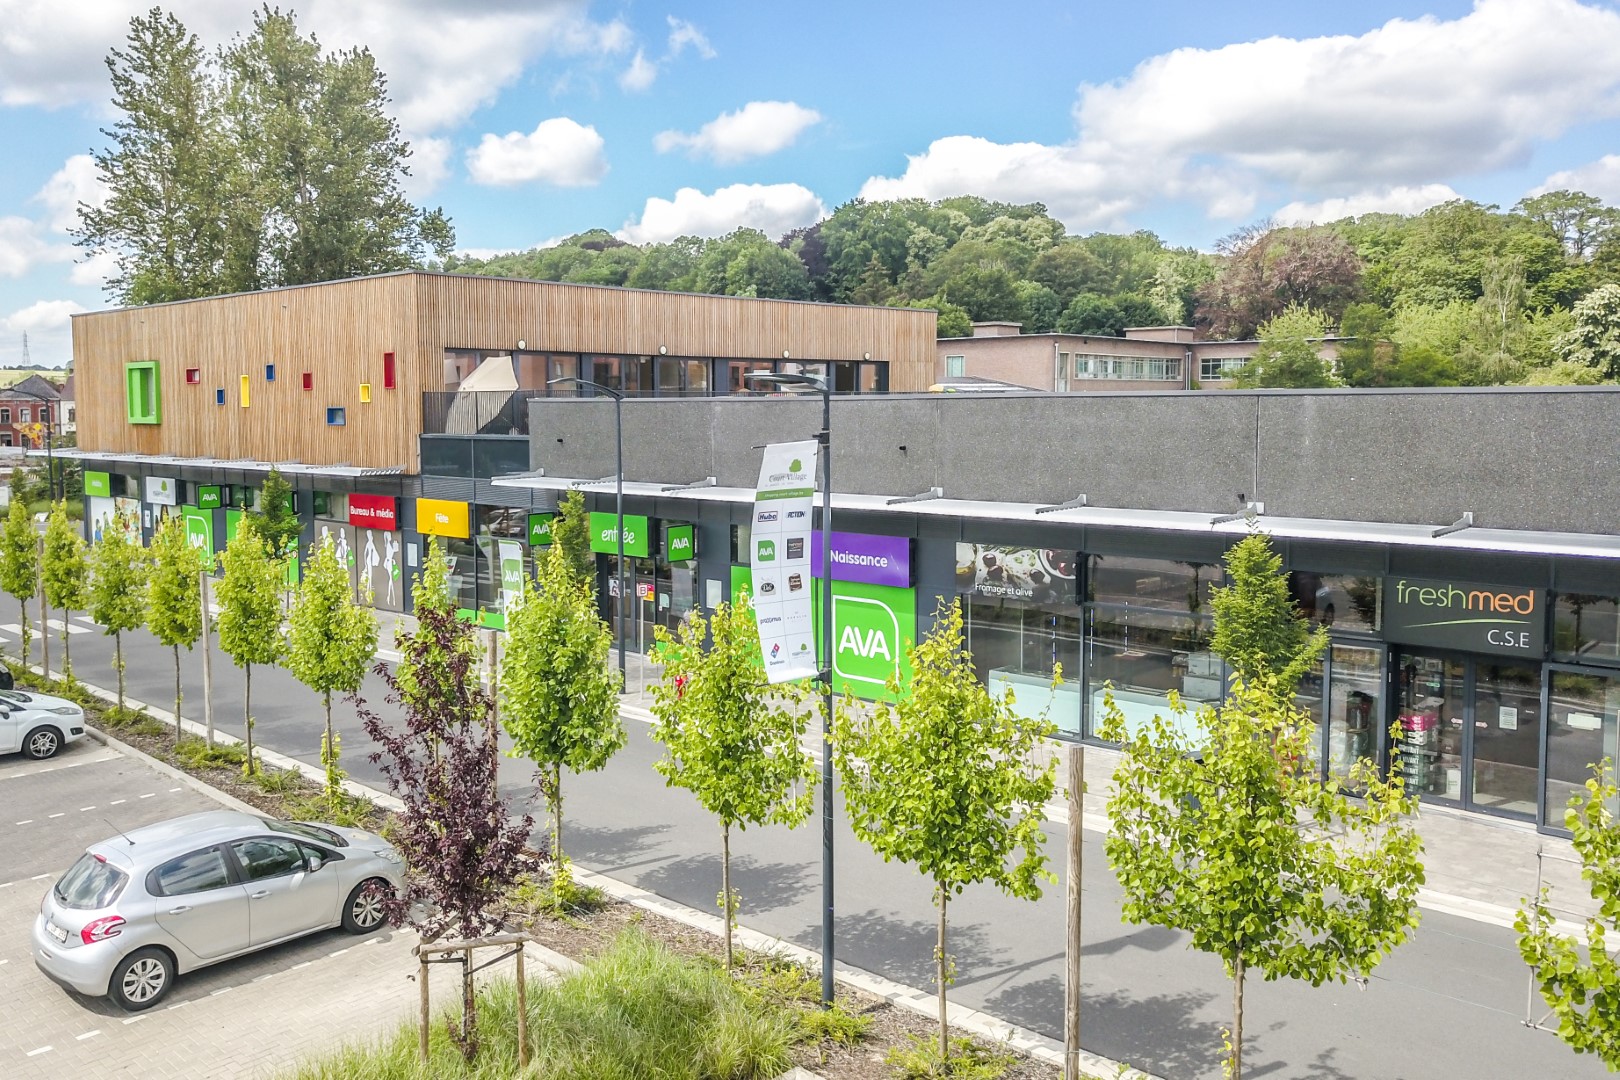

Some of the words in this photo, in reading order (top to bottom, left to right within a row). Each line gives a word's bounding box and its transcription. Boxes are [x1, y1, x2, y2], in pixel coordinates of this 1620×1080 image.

[202, 493, 218, 502] AVA
[350, 505, 369, 516] Bureau
[370, 507, 375, 516] &
[376, 508, 394, 519] média
[532, 523, 550, 535] AVA
[601, 525, 635, 544] entée
[671, 537, 690, 550] AVA
[758, 547, 774, 556] AVA
[830, 549, 888, 568] Naissance
[504, 569, 521, 583] AVA
[975, 583, 1006, 595] Fromage
[1015, 588, 1033, 597] olive
[1396, 580, 1535, 615] freshmed
[838, 625, 891, 662] AVA
[1487, 629, 1530, 648] C.S.E
